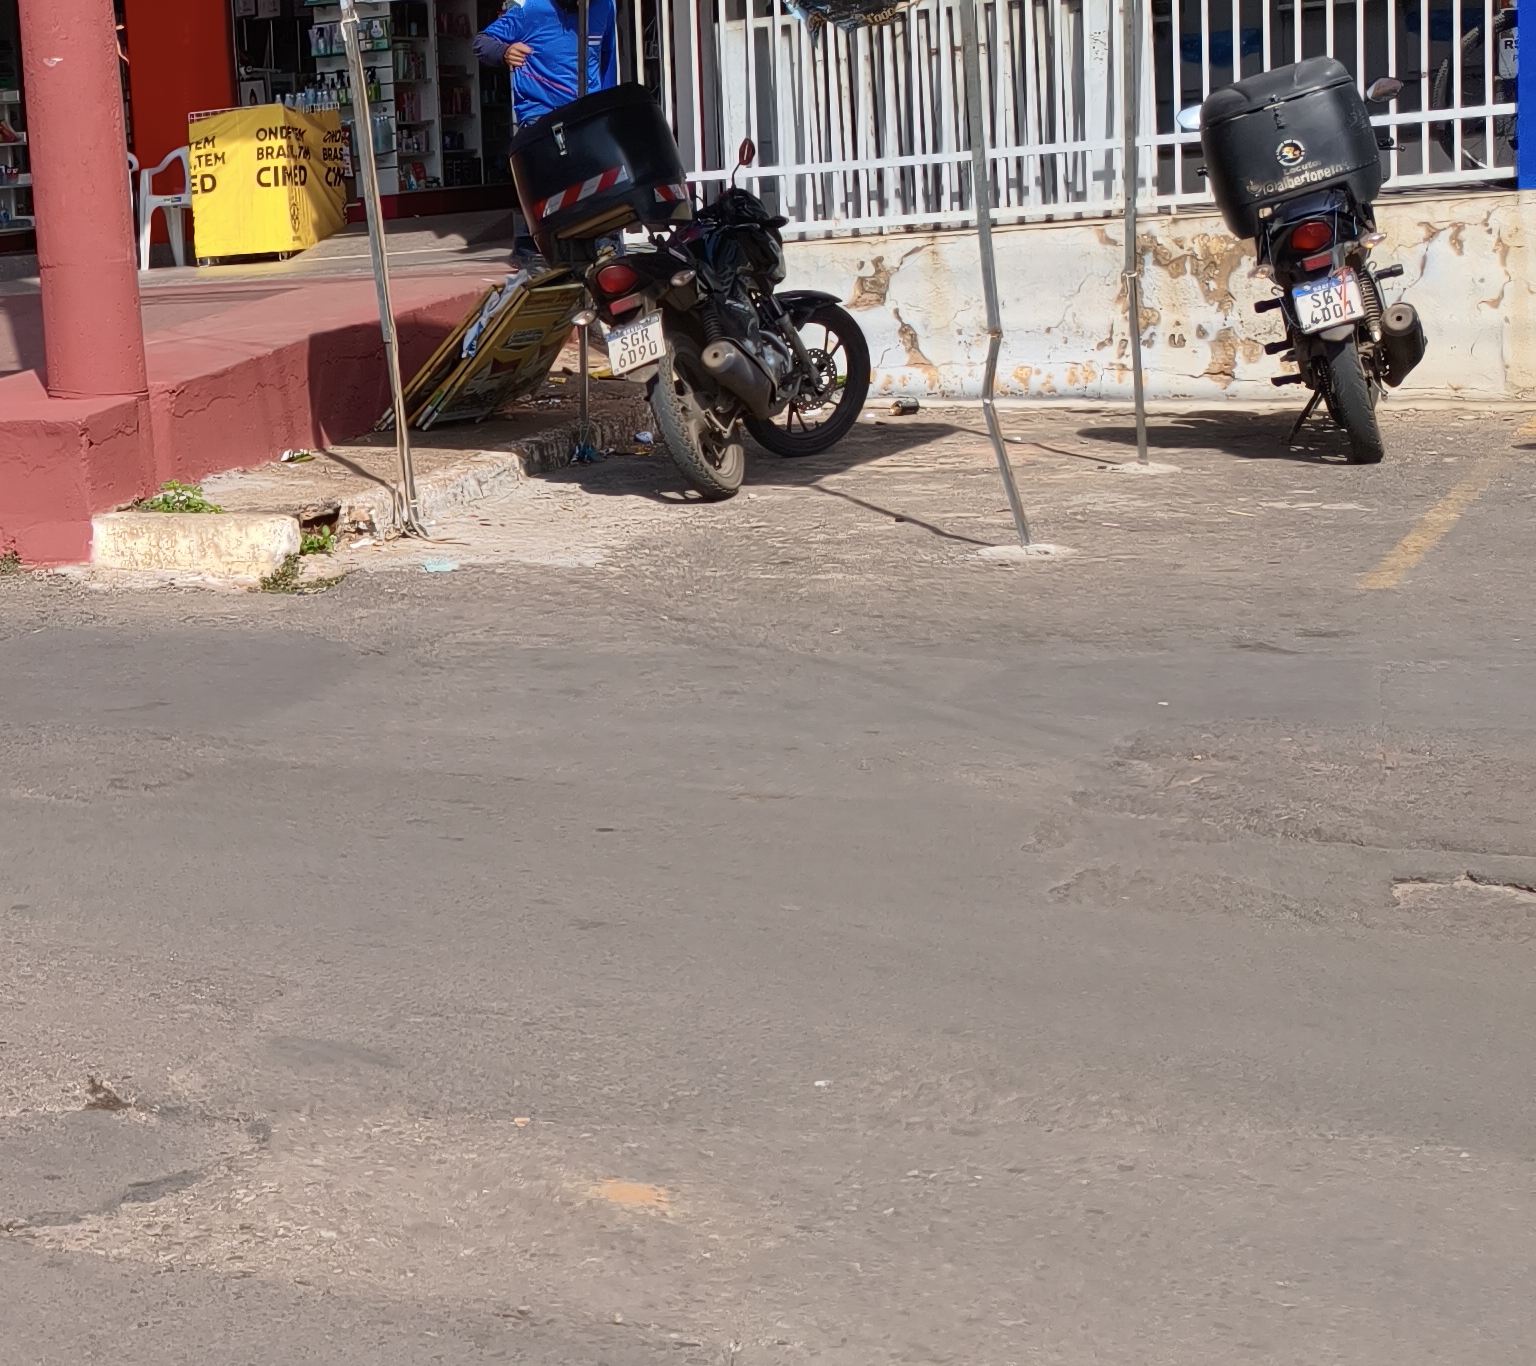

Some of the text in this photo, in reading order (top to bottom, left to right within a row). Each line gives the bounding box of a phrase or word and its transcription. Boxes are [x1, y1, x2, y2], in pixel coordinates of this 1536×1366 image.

[256, 165, 307, 188] CIMED
[620, 328, 650, 351] SGR
[618, 340, 658, 369] 6D90
